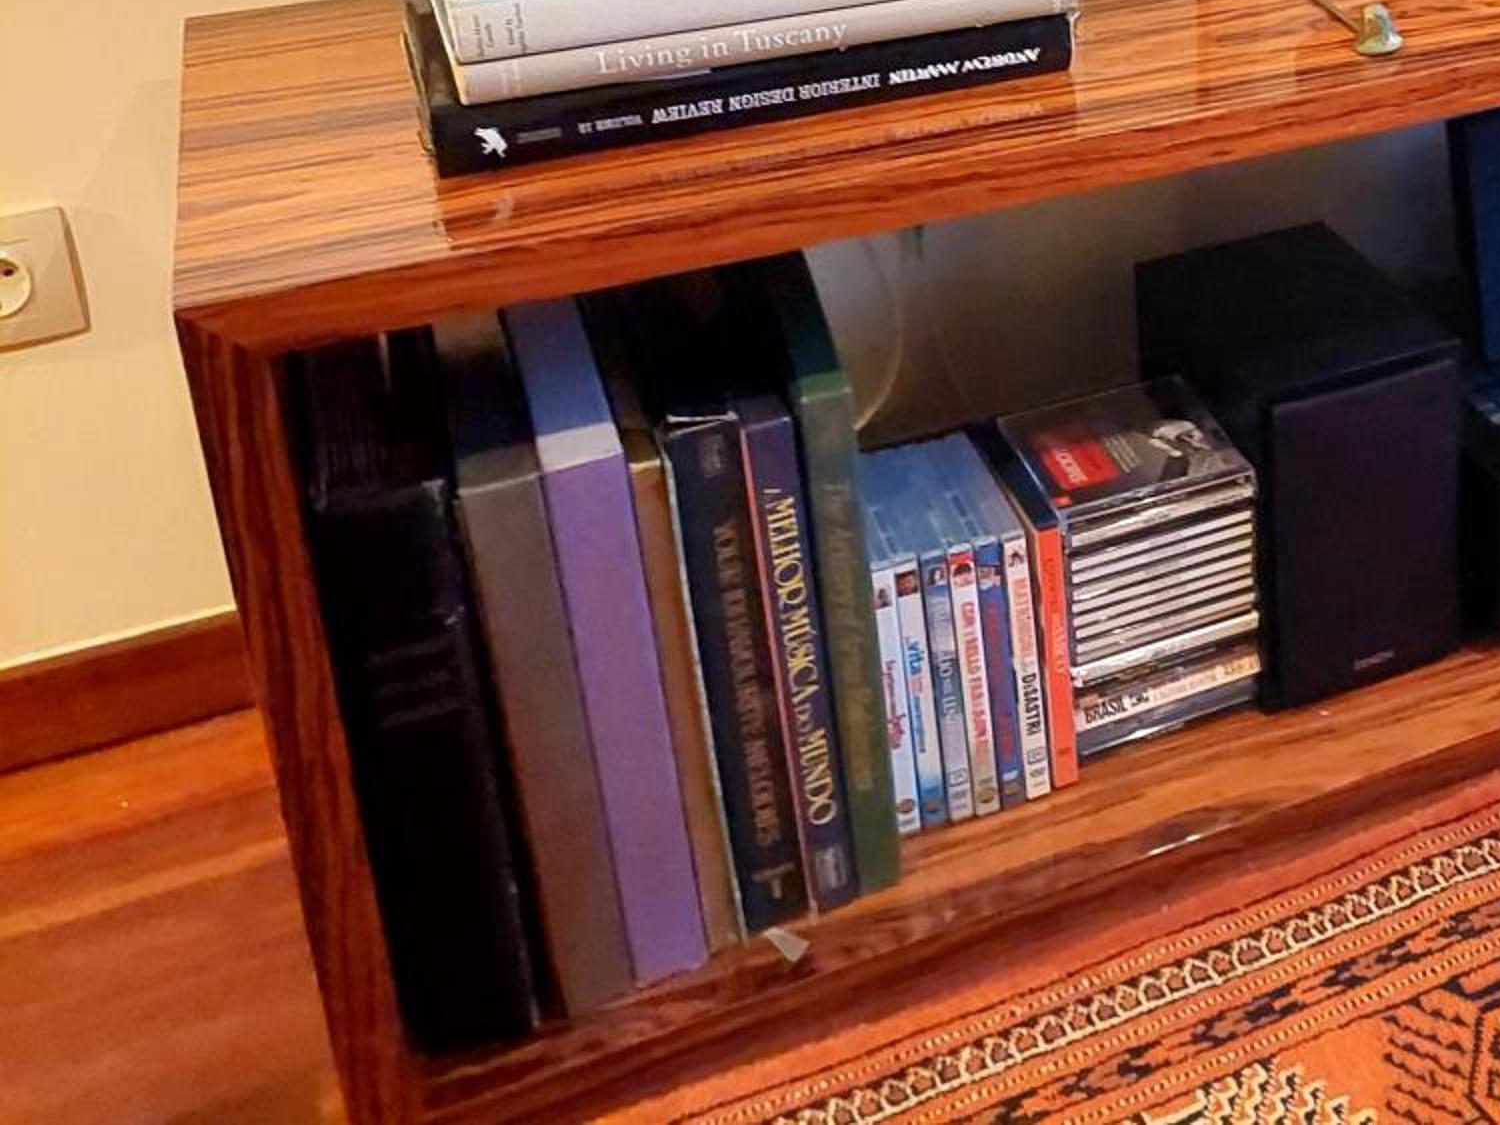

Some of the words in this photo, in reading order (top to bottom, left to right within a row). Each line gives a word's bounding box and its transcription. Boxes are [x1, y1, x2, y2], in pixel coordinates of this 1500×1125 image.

[599, 45, 692, 75] Living
[701, 36, 729, 59] in
[735, 23, 848, 52] Tuscany
[961, 47, 1042, 75] ANDREW
[799, 72, 881, 101] INTERIOR
[889, 61, 962, 86] MARTIN
[651, 97, 722, 124] REVIEW
[728, 87, 796, 112] DESIGN
[767, 495, 808, 605] MELHOR
[800, 728, 838, 827] MUNDO
